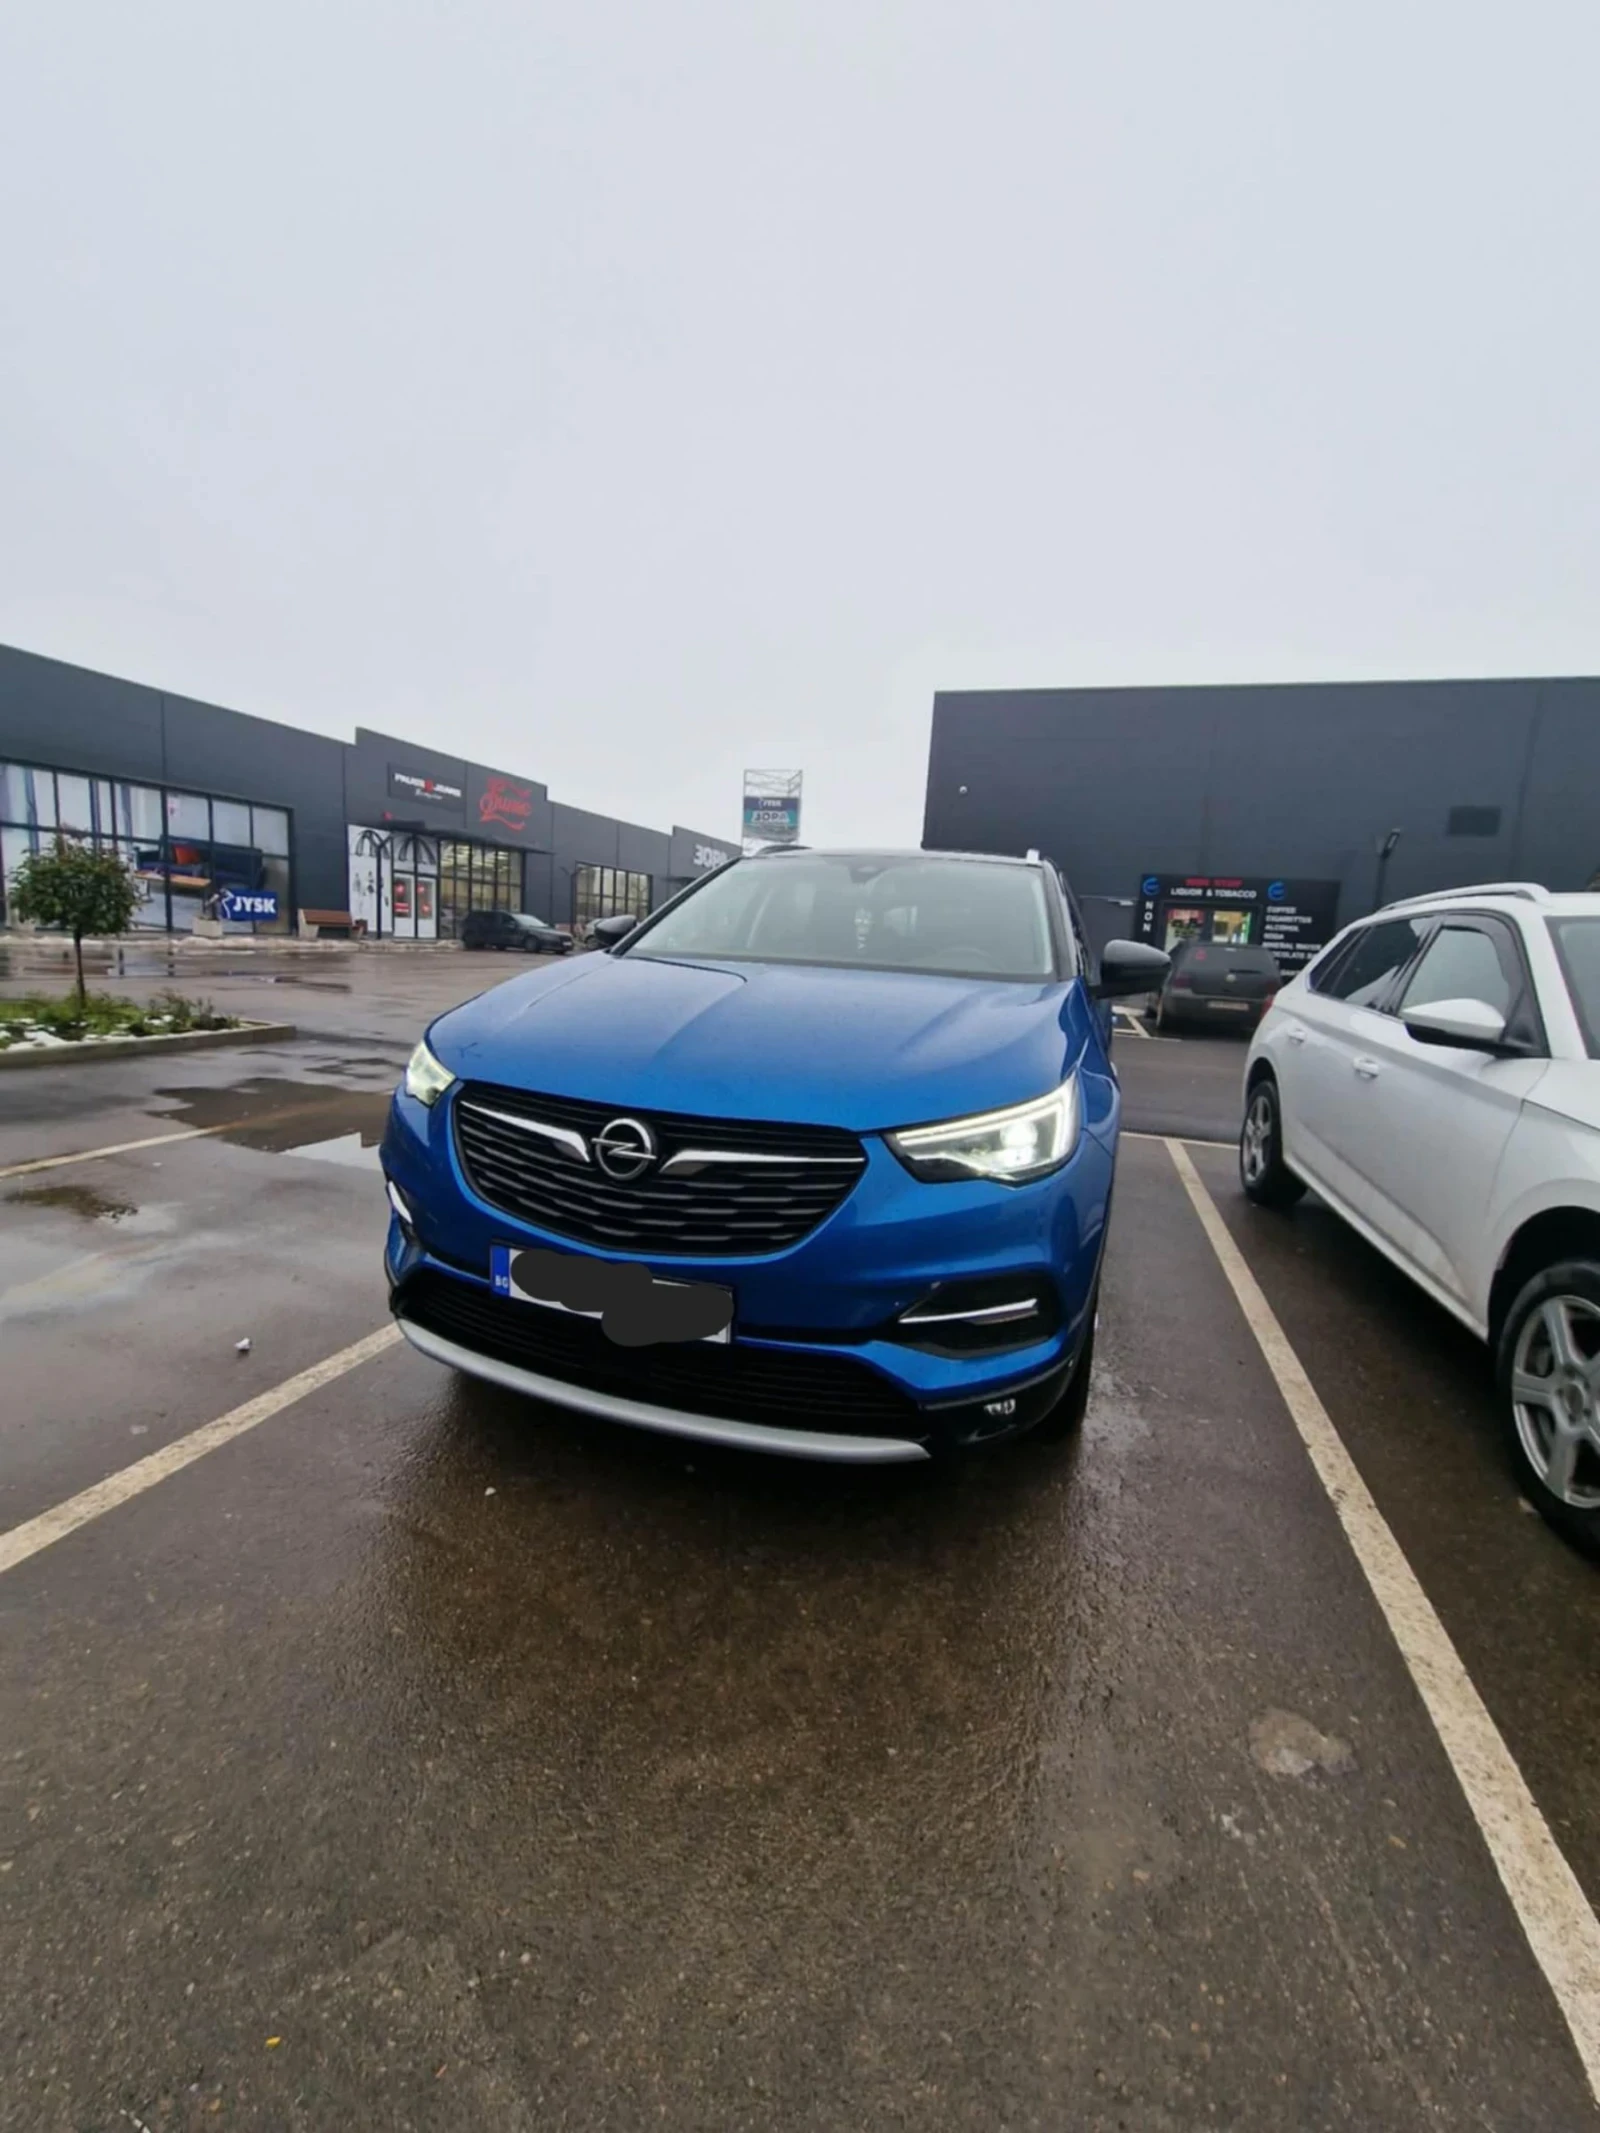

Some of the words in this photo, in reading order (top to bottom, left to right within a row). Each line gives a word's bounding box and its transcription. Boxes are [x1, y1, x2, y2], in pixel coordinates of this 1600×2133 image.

[1215, 889, 1257, 899] TOBACCO
[233, 896, 276, 913] JYSK
[495, 1275, 509, 1288] BG
